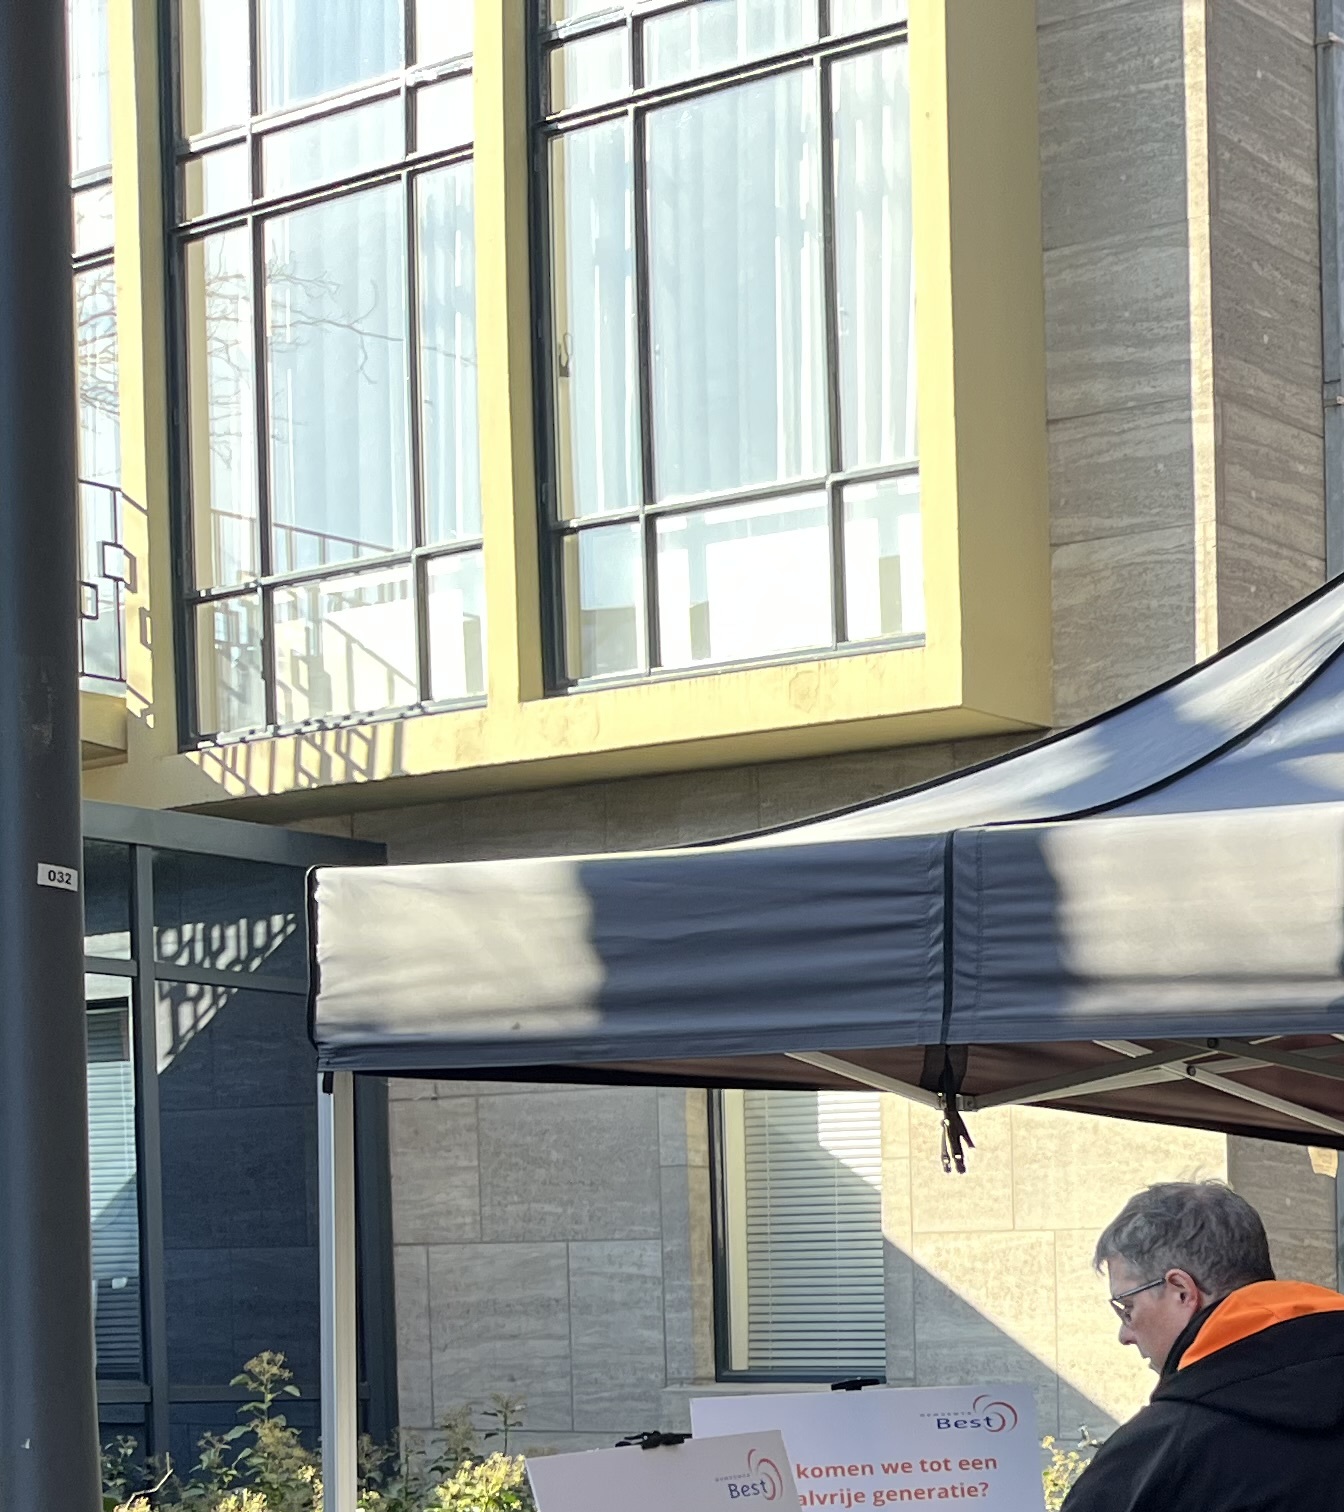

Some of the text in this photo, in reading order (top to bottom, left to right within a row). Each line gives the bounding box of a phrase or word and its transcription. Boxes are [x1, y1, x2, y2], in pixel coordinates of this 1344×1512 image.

[47, 869, 72, 885] 032
[936, 1415, 994, 1431] Best
[796, 1455, 997, 1480] komen we tot een
[728, 1479, 768, 1499] Best
[873, 1481, 989, 1507] generatie?
